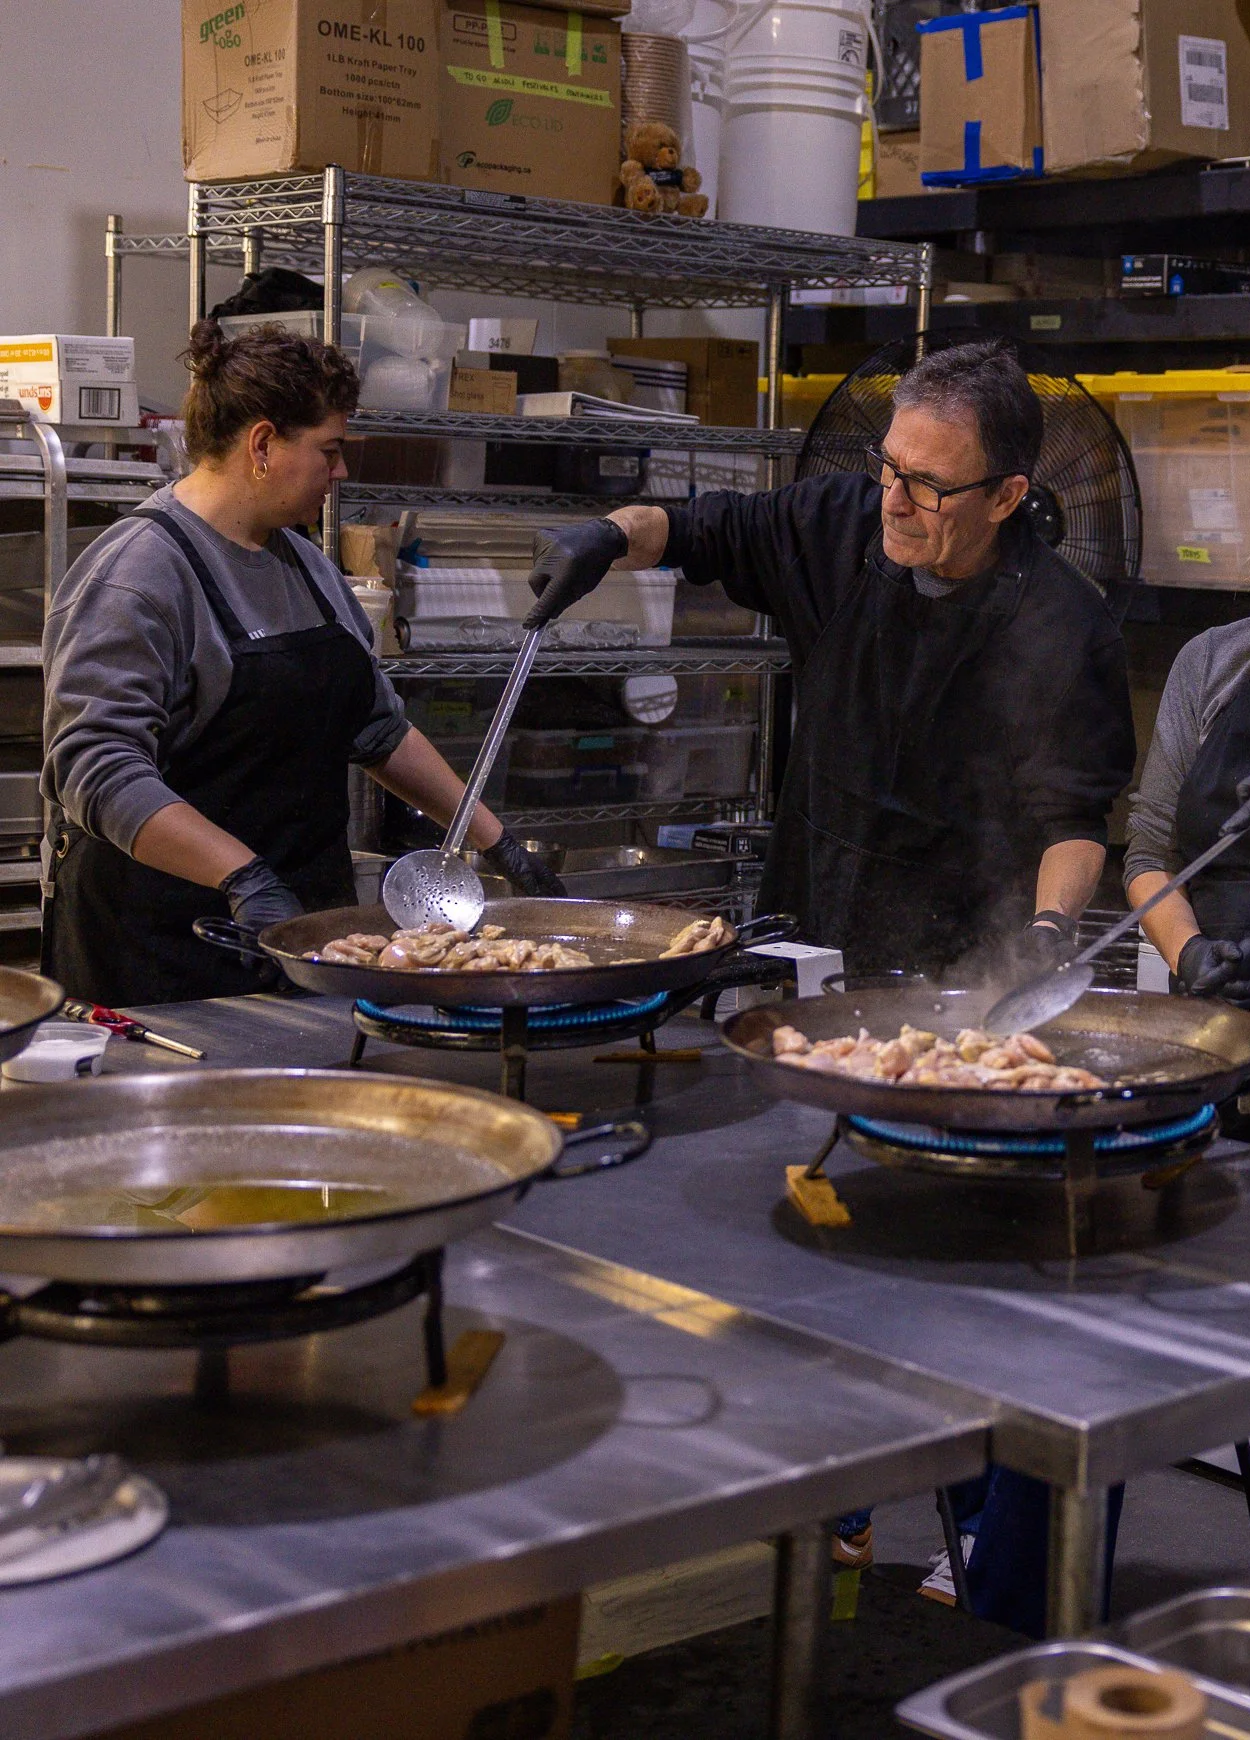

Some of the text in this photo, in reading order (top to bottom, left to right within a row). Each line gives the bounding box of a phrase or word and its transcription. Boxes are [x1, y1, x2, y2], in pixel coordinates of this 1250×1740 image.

[200, 3, 245, 44] green
[317, 20, 392, 47] OME-KL
[398, 33, 425, 53] 100
[244, 47, 286, 67] OME-KL 100
[326, 53, 417, 78] 1LB Kraft Paper Tray
[320, 85, 354, 98] Bottom
